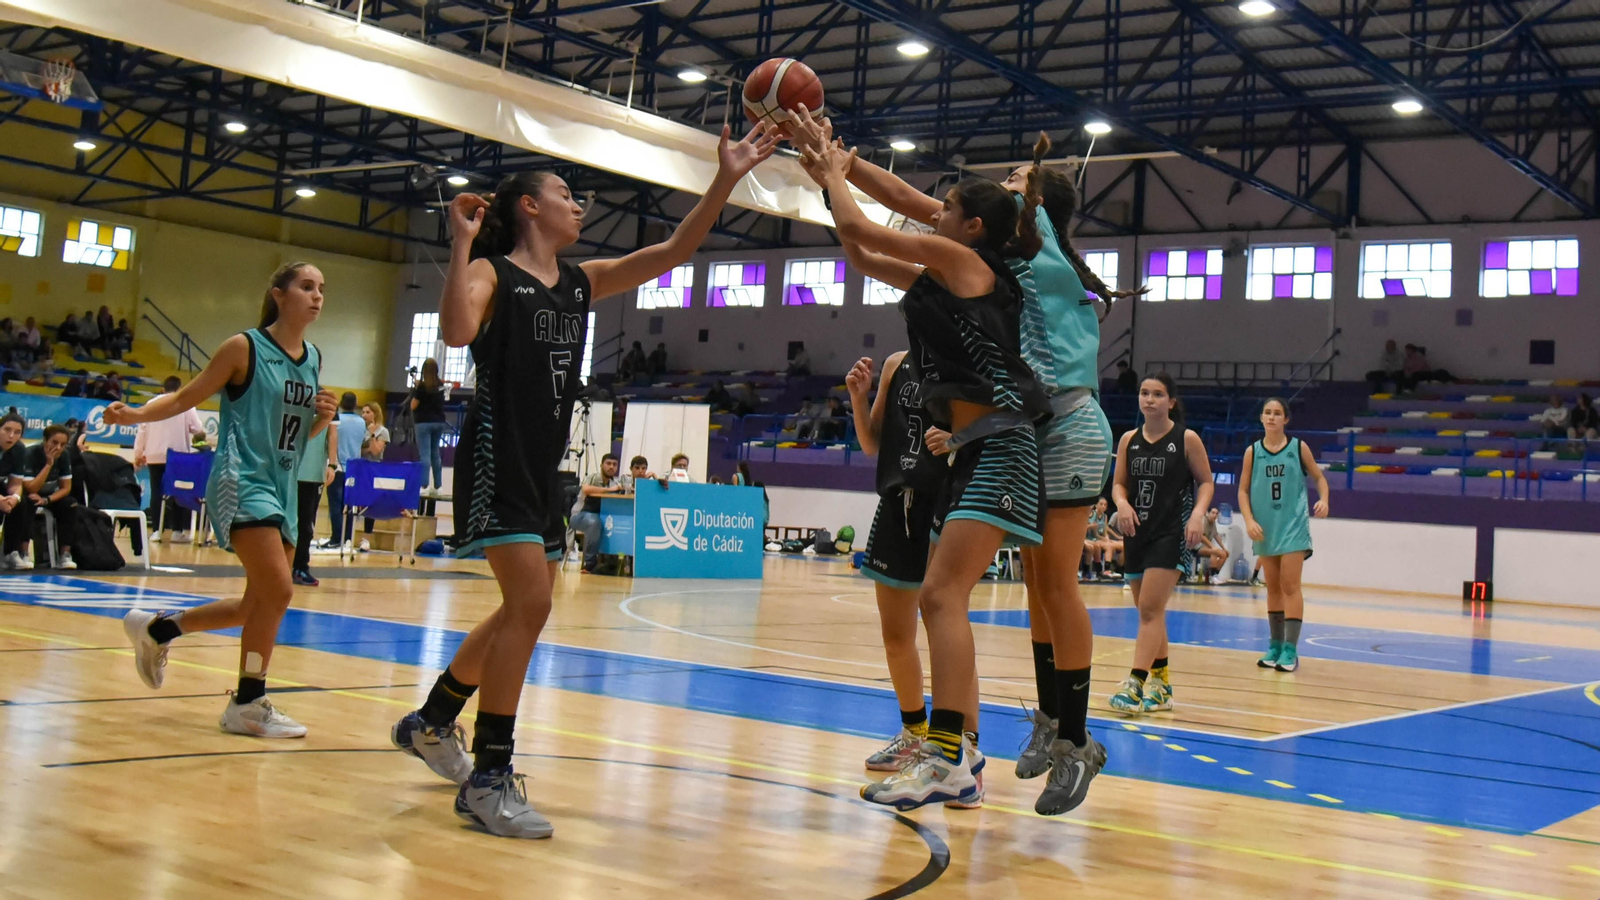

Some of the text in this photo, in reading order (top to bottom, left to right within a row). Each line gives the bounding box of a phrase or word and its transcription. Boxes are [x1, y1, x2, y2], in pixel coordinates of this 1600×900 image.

[514, 286, 535, 294] vive
[534, 309, 582, 344] ALM
[266, 358, 284, 366] vive
[549, 350, 572, 399] 5
[897, 381, 923, 409] AL
[278, 413, 301, 452] 12
[907, 414, 923, 455] 3
[1131, 456, 1166, 477] ALM
[1134, 479, 1157, 509] 13
[1271, 481, 1282, 501] 8
[693, 508, 755, 530] Diputación
[693, 534, 744, 553] de Cádiz
[872, 558, 888, 570] vive
[1471, 581, 1487, 600] 17
